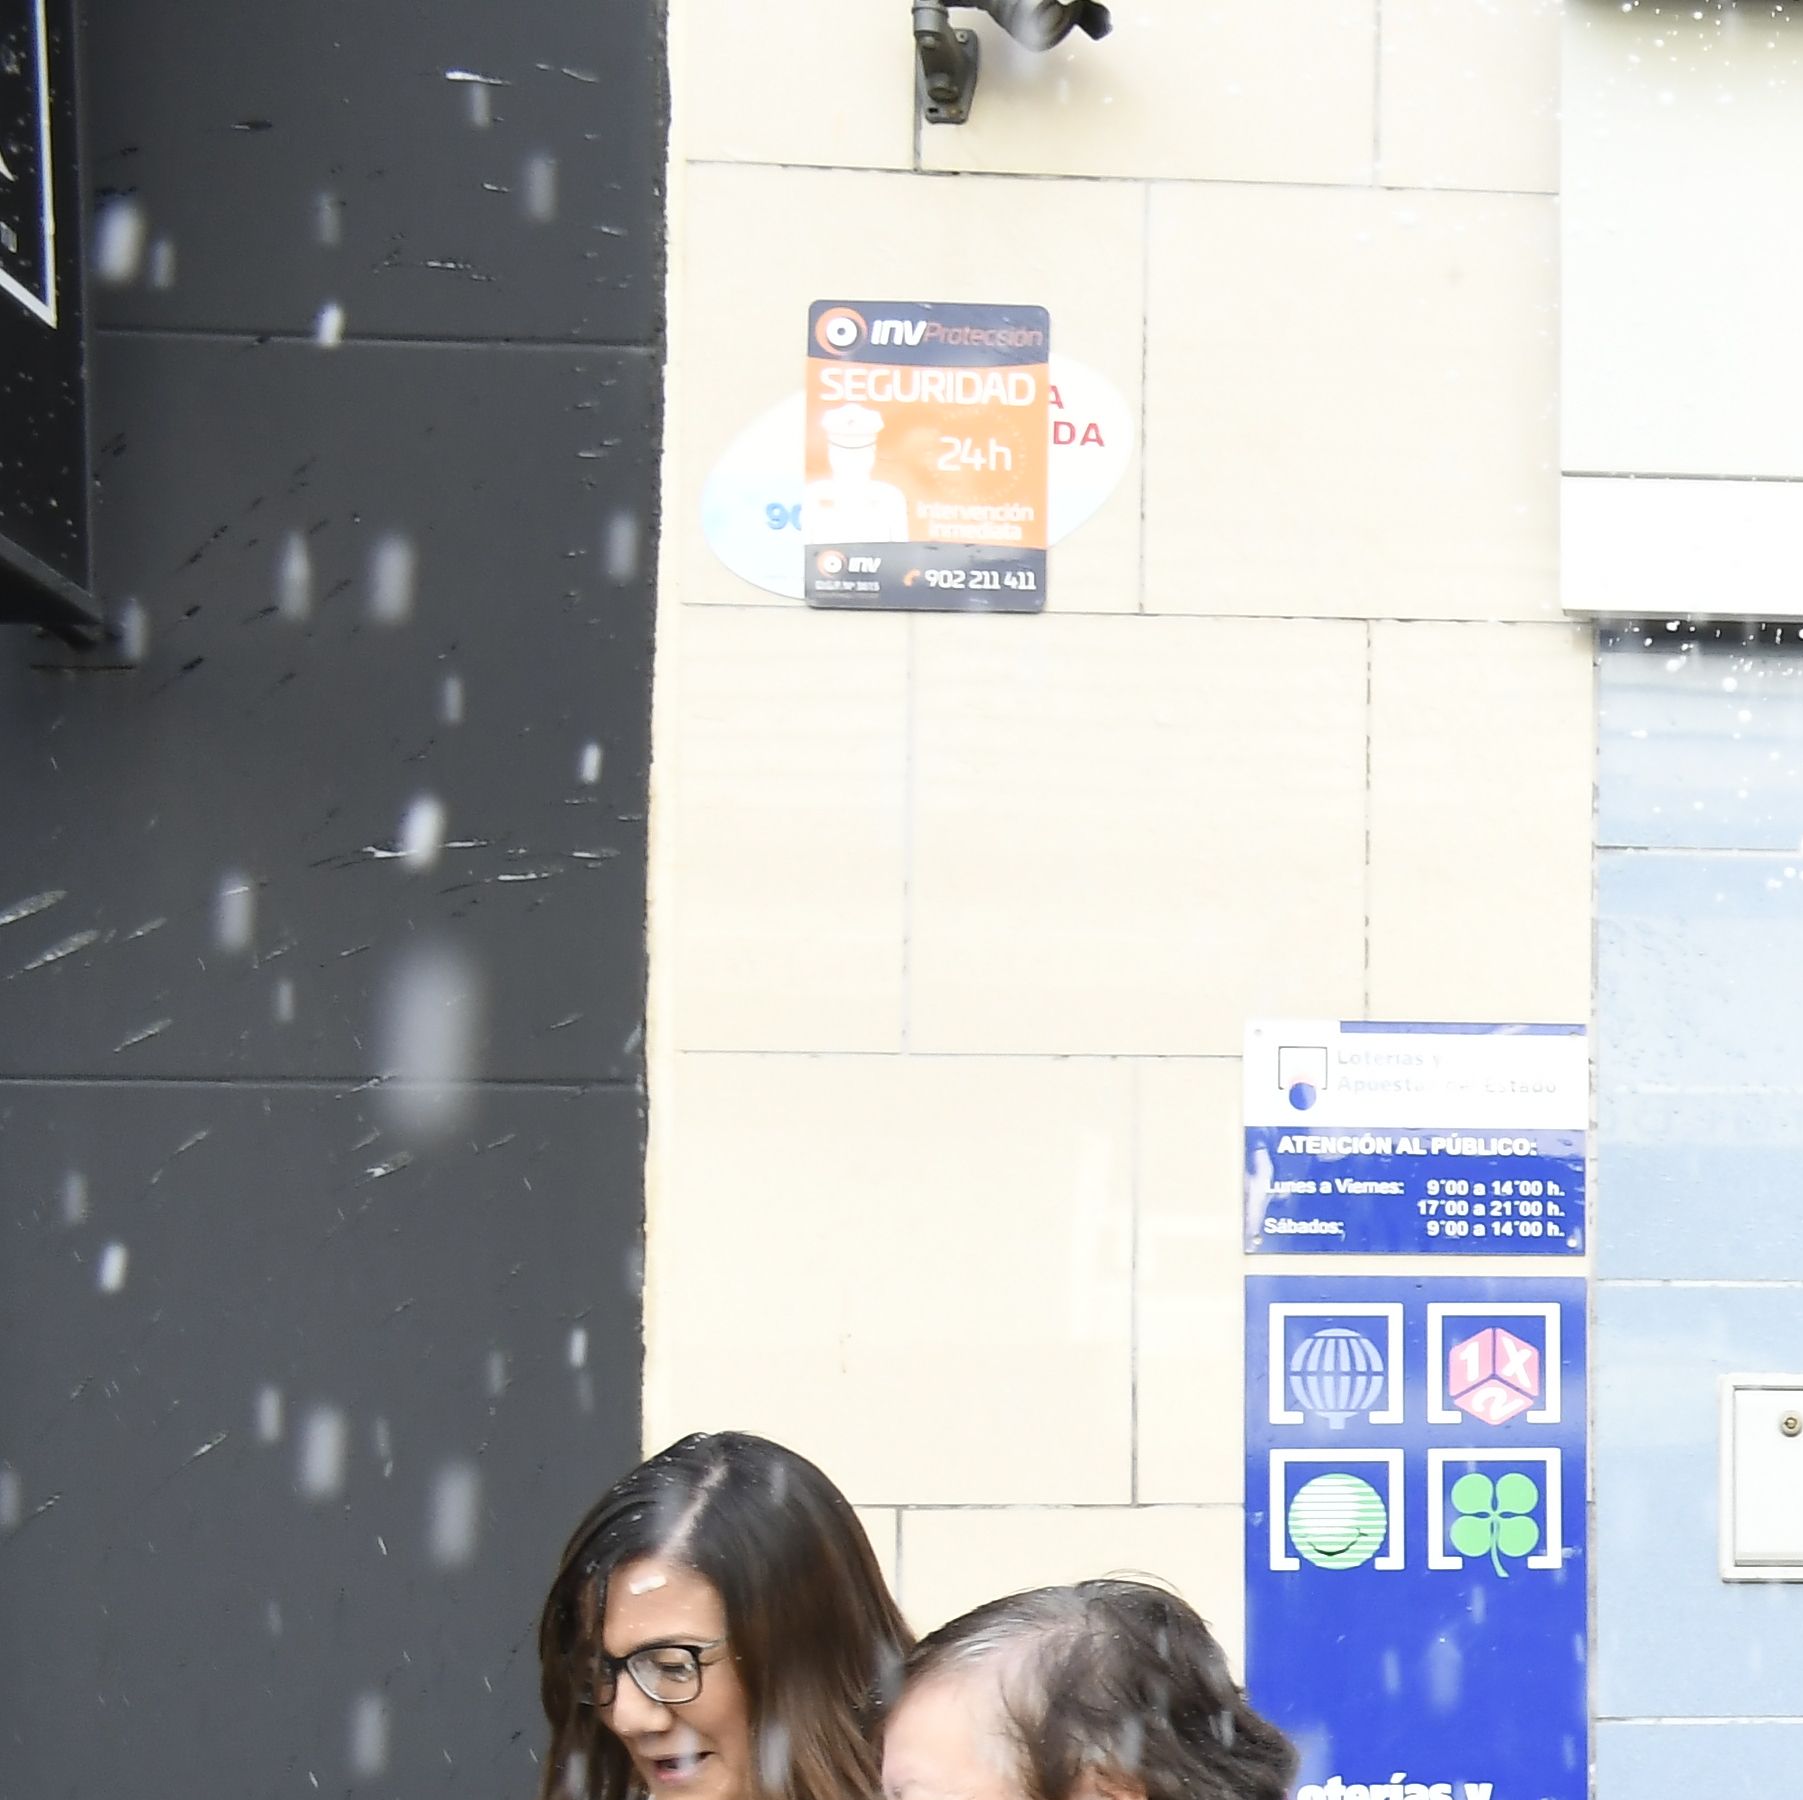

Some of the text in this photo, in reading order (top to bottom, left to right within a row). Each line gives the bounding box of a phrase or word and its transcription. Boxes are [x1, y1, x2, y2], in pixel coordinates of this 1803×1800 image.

[820, 366, 1037, 406] SEGURIDAD
[1053, 421, 1105, 447] DA
[936, 434, 1013, 472] 24h
[924, 569, 1037, 590] 902 211 411
[1277, 1132, 1393, 1155] ATENCIÓN
[1395, 1137, 1427, 1155] AL
[1265, 1178, 1317, 1195] Lunes
[1319, 1181, 1332, 1195] a
[1472, 1183, 1486, 1197] a
[1472, 1204, 1486, 1217] a
[1472, 1224, 1486, 1237] a
